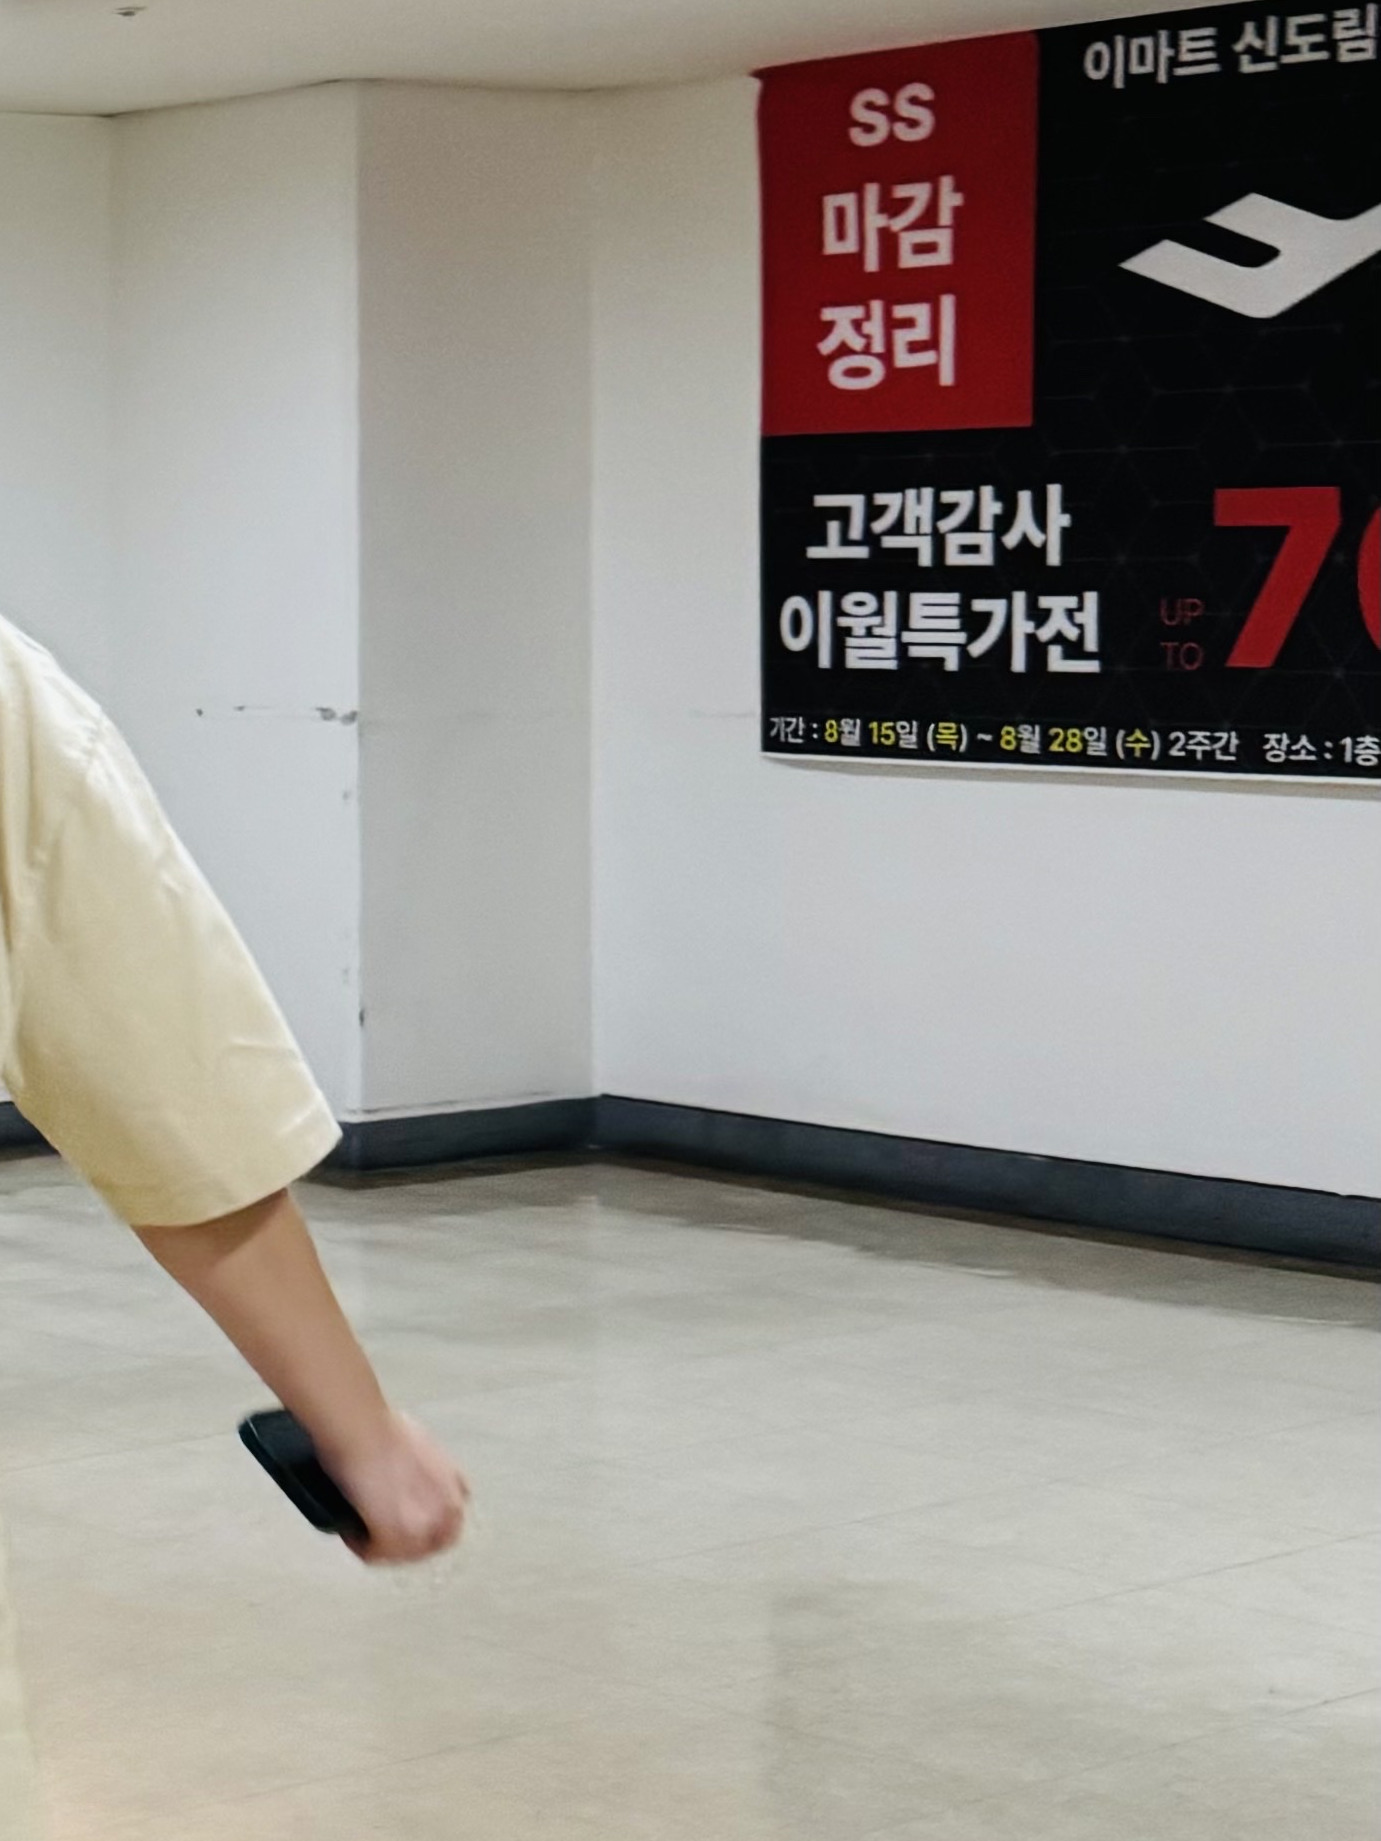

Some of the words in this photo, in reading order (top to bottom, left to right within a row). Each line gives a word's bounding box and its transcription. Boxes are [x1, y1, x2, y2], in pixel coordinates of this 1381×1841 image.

[1083, 26, 1222, 90] 이마트
[1231, 2, 1379, 74] 신도림
[848, 81, 936, 147] SS
[822, 174, 965, 273] 마감
[816, 293, 956, 390] 정리
[805, 483, 1073, 567] 고객감사
[779, 590, 1101, 673] 이월특가전
[1160, 597, 1205, 627] UP
[1159, 641, 1205, 671] TO
[769, 716, 806, 744] 기간
[823, 718, 862, 748] 8월
[868, 719, 919, 750] 15일
[926, 721, 969, 753] (목)
[999, 724, 1042, 755] 8월
[1048, 726, 1108, 757] 28일
[1115, 728, 1162, 761] (수)
[1168, 729, 1240, 761] 2주간
[1261, 732, 1318, 763] 장소
[1339, 734, 1381, 767] 1층
